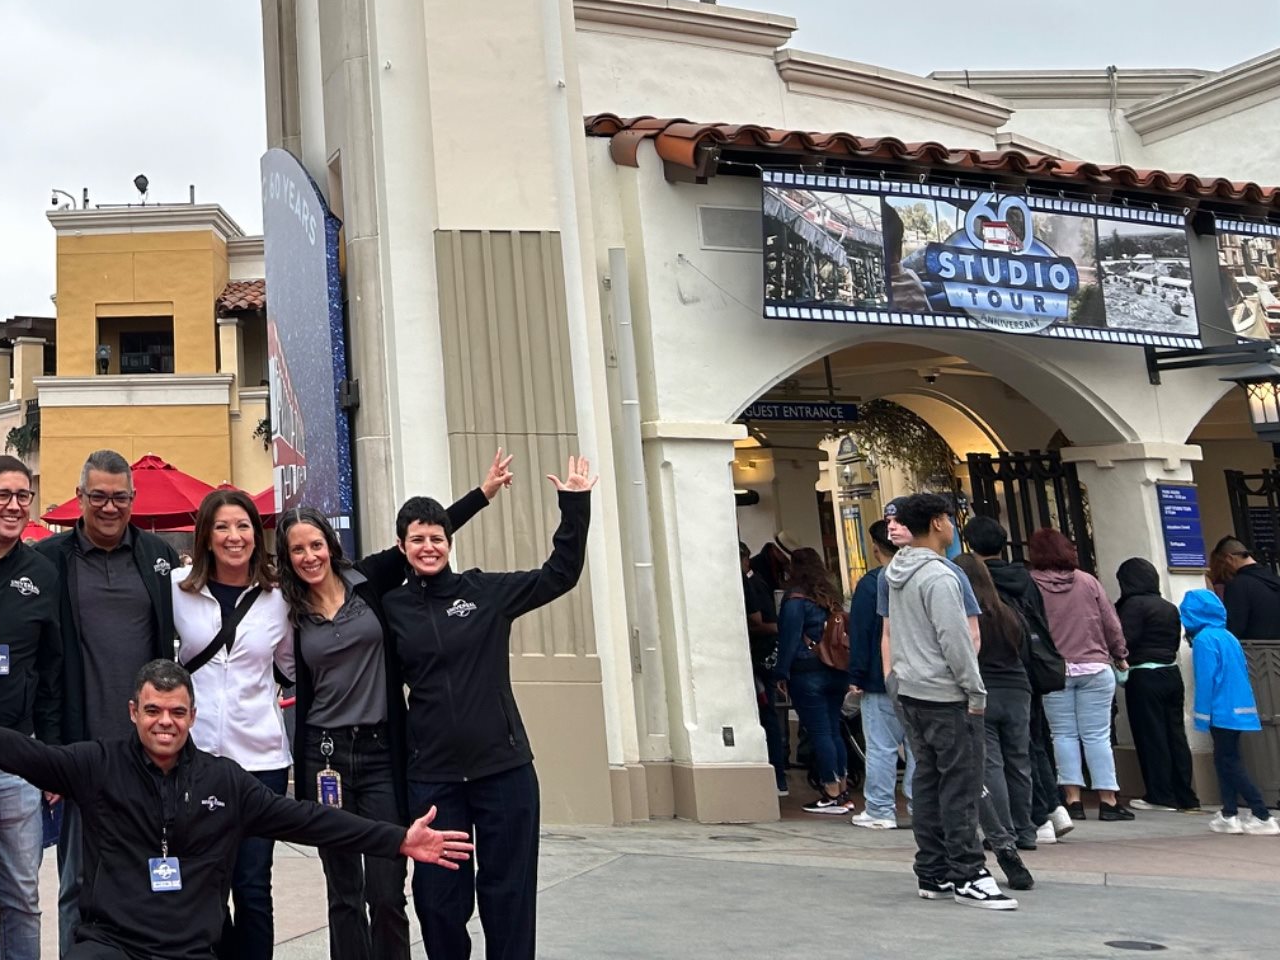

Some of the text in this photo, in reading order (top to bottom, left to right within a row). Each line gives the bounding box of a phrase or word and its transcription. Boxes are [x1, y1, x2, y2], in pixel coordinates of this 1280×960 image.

[270, 172, 280, 199] 60
[283, 174, 317, 246] YEARS
[964, 191, 1034, 256] 60
[938, 251, 1070, 290] STUDIO
[967, 287, 1047, 313] TOUR
[980, 313, 1041, 330] ANNIVERSARY
[744, 404, 844, 419] GUEST ENTRANCE
